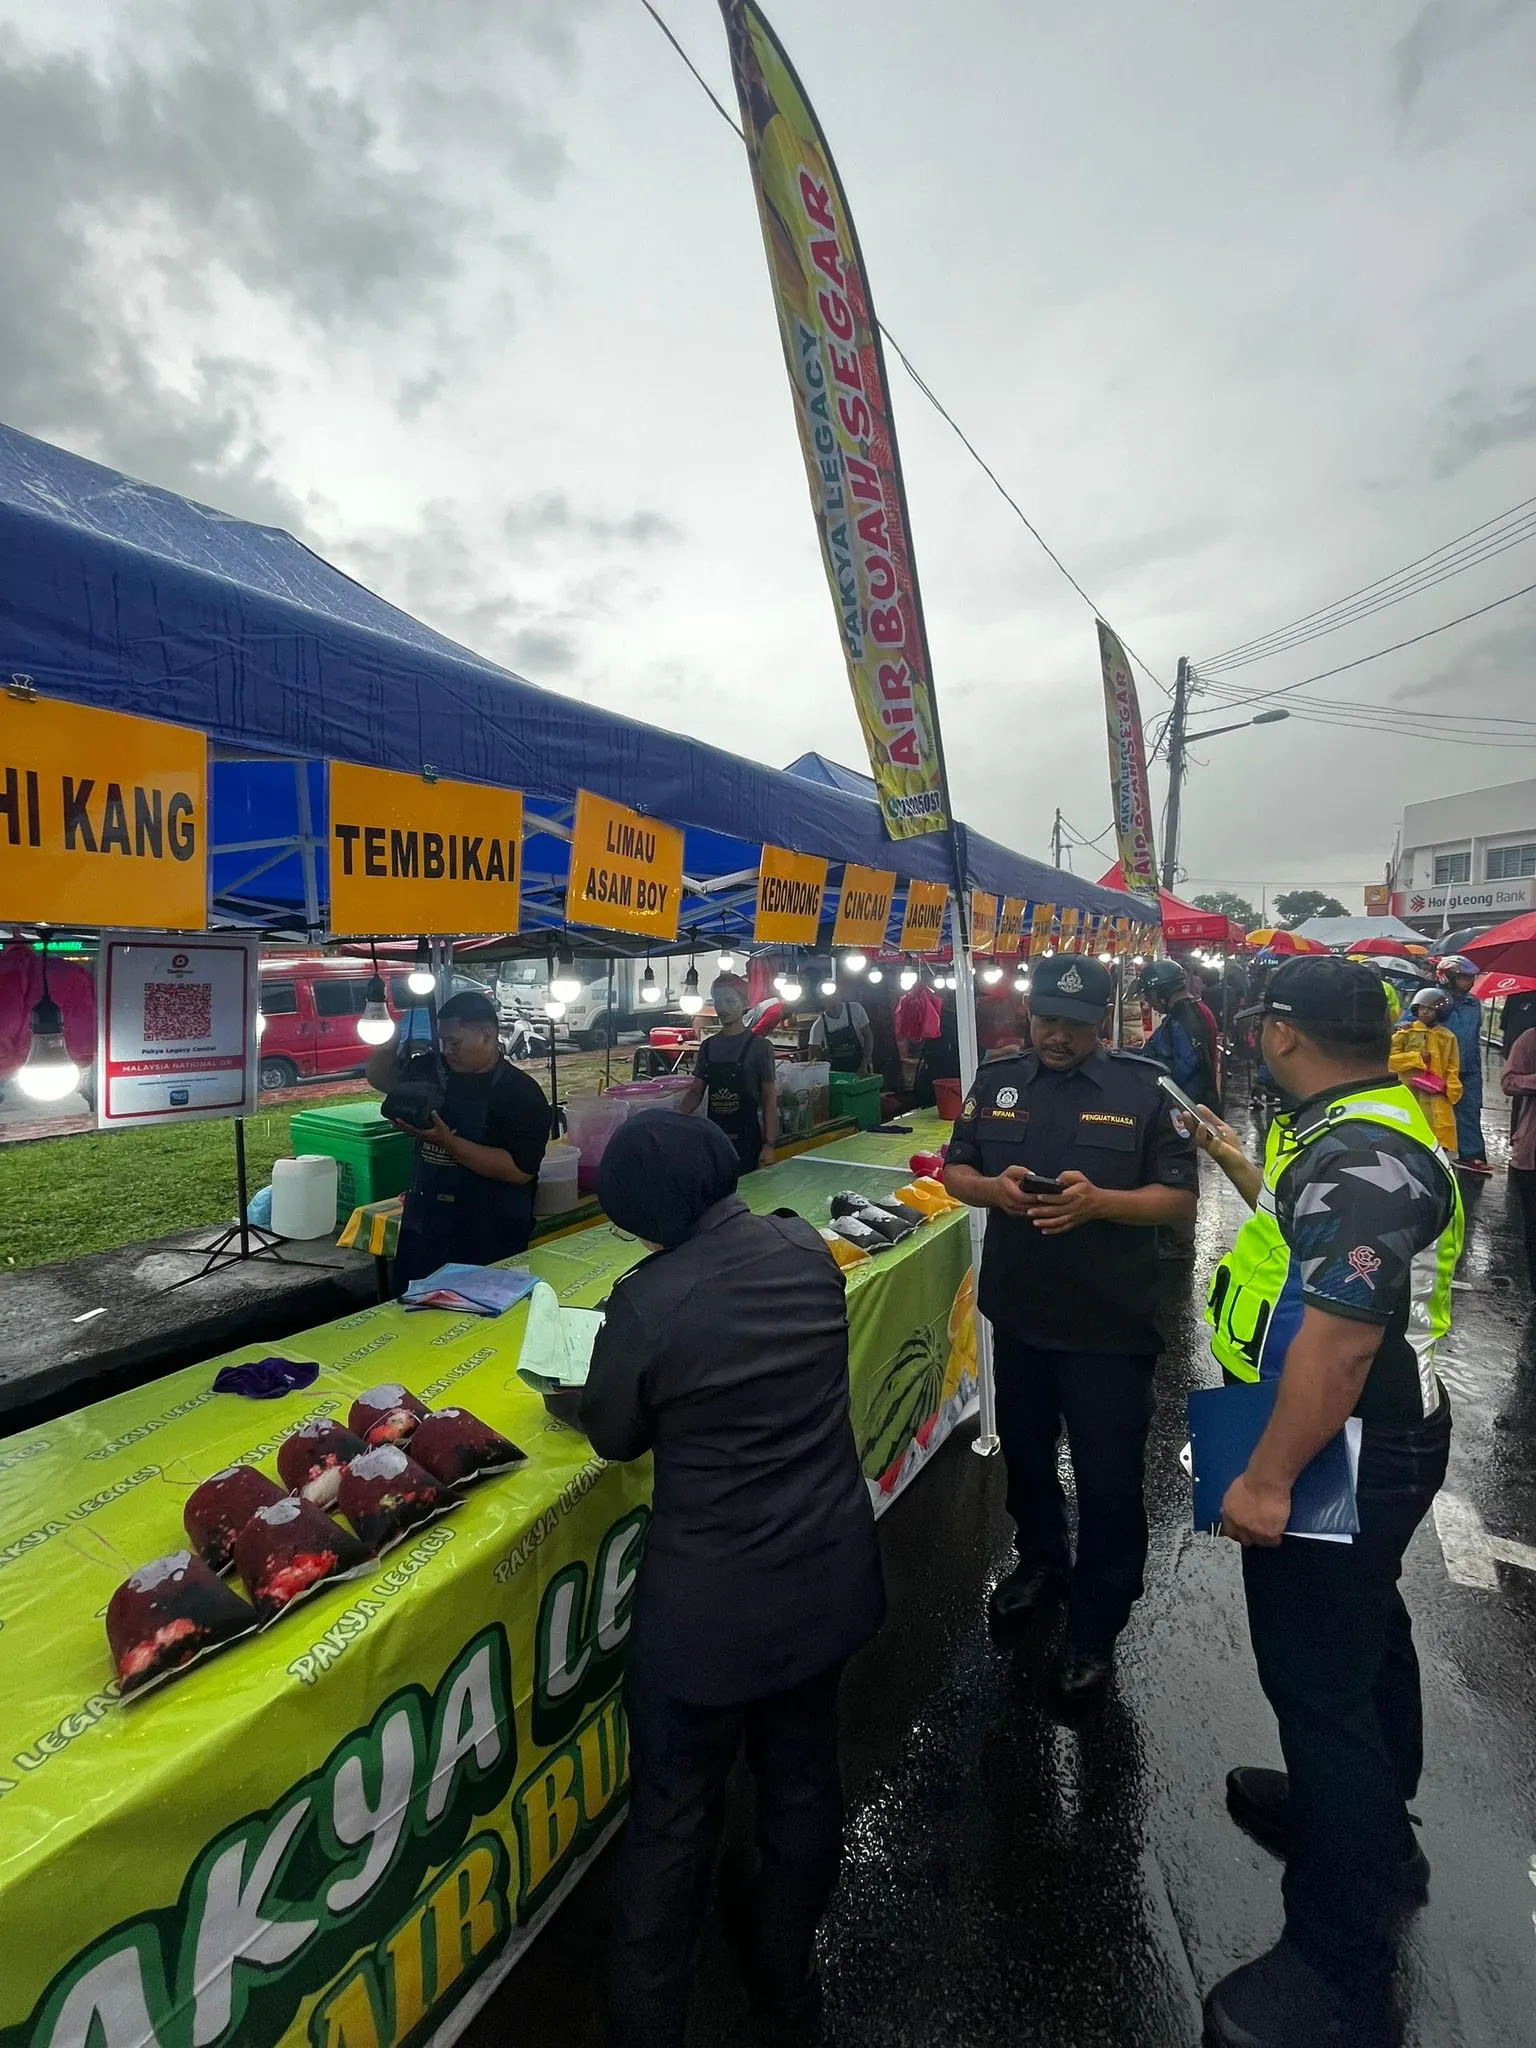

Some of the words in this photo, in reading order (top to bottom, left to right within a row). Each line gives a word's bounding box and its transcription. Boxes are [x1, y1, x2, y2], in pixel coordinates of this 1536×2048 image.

[799, 169, 872, 440] SEGAR
[800, 322, 845, 511] LEGACY
[846, 455, 904, 646] BUAH
[830, 520, 863, 659] PAKYA
[62, 776, 196, 862] KANG
[1121, 783, 1130, 833] PAKYA
[335, 825, 516, 882] TEMBIKAI
[606, 821, 656, 864] LIMAU
[586, 867, 632, 907] ASAM
[637, 879, 668, 914] BOY
[761, 877, 820, 916] KEDONDONG
[844, 891, 887, 921] CINCAU
[1496, 890, 1526, 903] Bank
[906, 904, 943, 929] JAGUNG
[123, 1064, 170, 1072] MALAYSIA
[173, 1060, 217, 1069] NATIONAL
[1081, 1113, 1134, 1126] PENGUATKUASA
[446, 1346, 498, 1379] LEGACY
[84, 1419, 168, 1461] PAKYA
[65, 1464, 164, 1521] LEGACY
[492, 1506, 560, 1585] PAKYA
[286, 1599, 386, 1686] PAKYA
[372, 1526, 458, 1598] LEGACY
[322, 1844, 498, 2048] AIR
